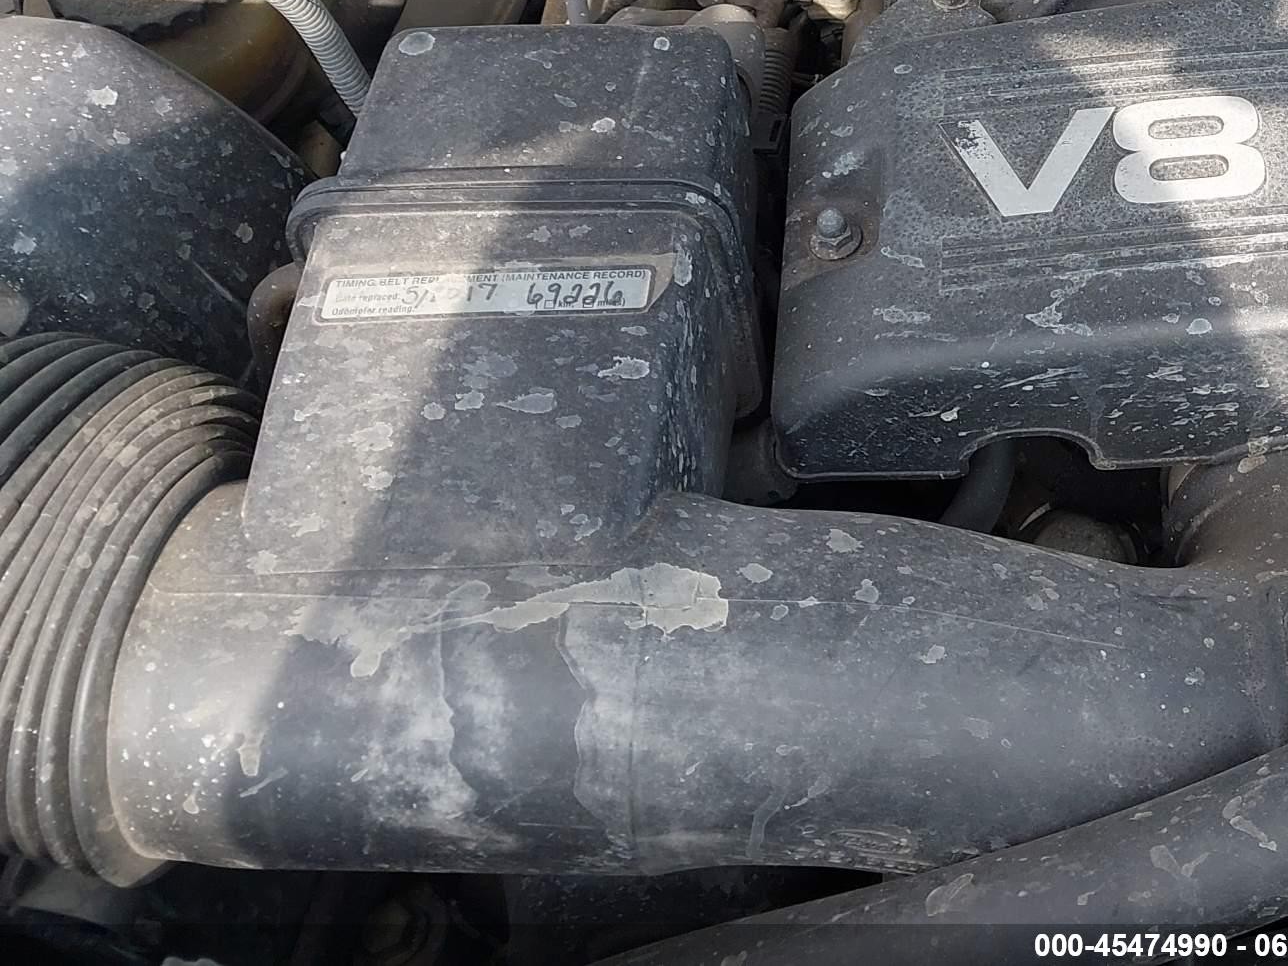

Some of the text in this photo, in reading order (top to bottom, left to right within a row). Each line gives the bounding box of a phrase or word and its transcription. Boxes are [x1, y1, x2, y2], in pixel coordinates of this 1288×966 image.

[939, 95, 1266, 216] V8
[336, 280, 375, 288] TIMING
[379, 278, 409, 286] BELT
[501, 271, 590, 283] (MAINTENANCE
[593, 270, 647, 279] RECORD)
[526, 280, 623, 309] 69226
